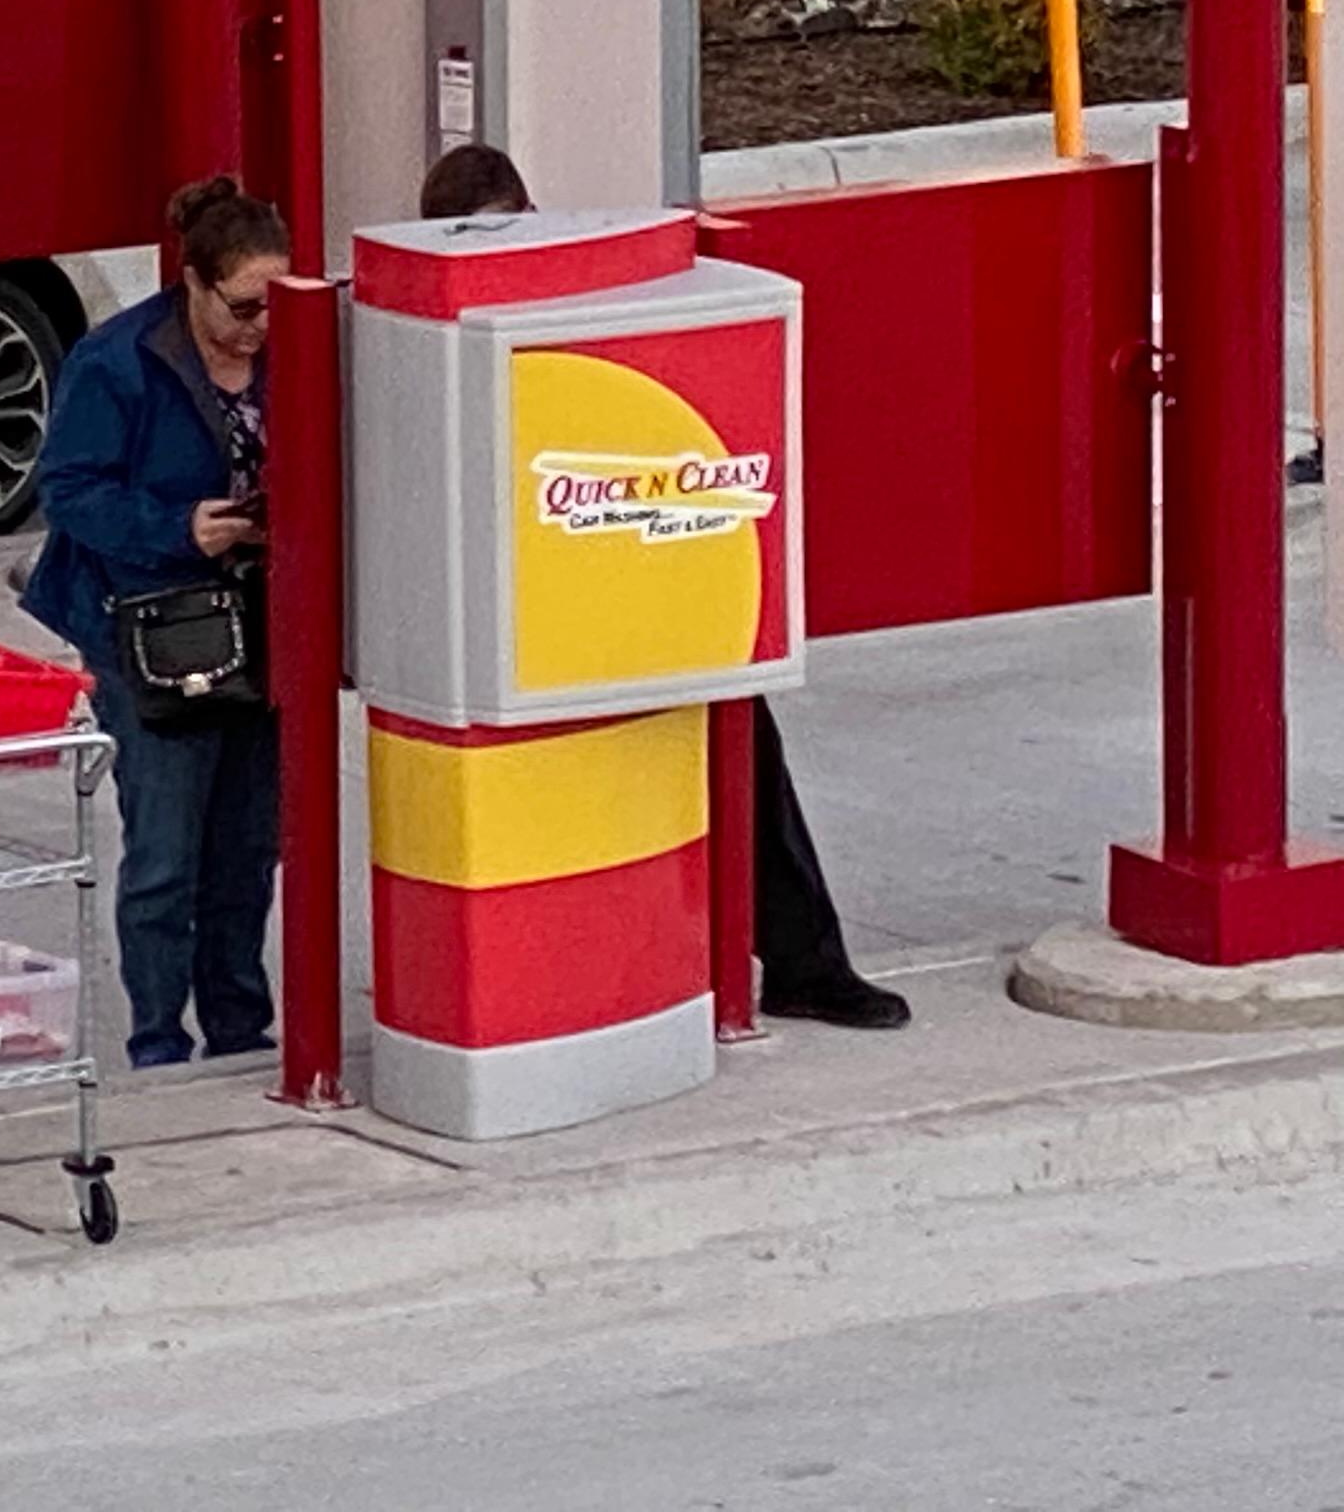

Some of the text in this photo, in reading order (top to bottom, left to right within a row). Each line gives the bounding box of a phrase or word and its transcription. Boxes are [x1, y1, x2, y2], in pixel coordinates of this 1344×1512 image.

[546, 459, 764, 515] QUICK N CLEAN
